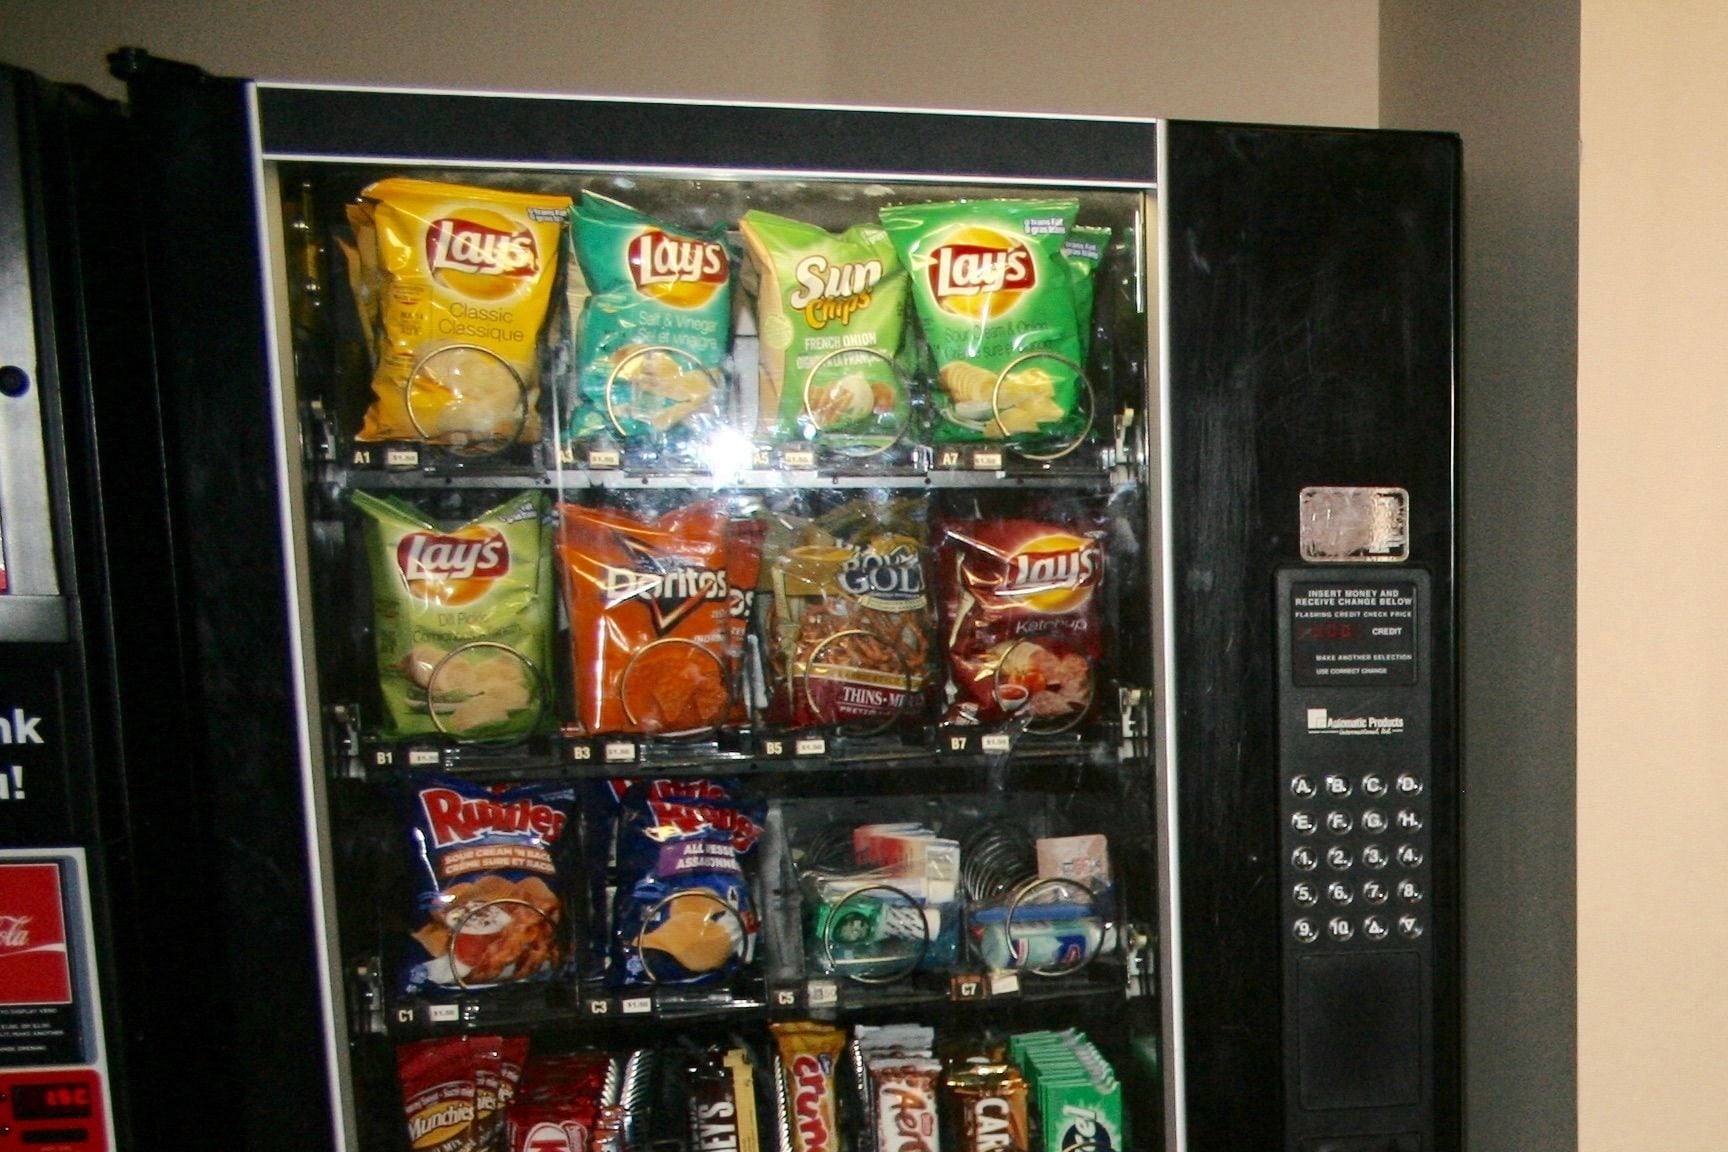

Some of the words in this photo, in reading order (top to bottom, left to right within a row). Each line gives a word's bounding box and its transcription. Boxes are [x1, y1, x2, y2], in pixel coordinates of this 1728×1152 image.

[434, 220, 535, 275] Lay's
[640, 235, 721, 285] Lay's
[938, 247, 1027, 296] Lay's
[791, 255, 883, 309] Sun
[450, 302, 513, 324] Classic
[804, 292, 873, 330] Chips
[439, 318, 524, 342] Classique
[805, 335, 841, 351] FRENCH
[843, 332, 877, 348] ONION
[354, 451, 371, 464] A1
[942, 451, 960, 466] A7
[407, 535, 503, 581] Lay's
[606, 566, 728, 600] Doritos
[839, 566, 924, 595] GOL
[1308, 589, 1342, 598] INSERT
[1344, 589, 1378, 598] MONEY
[1380, 589, 1399, 598] AND
[1016, 617, 1088, 635] Ketchup
[1371, 627, 1402, 636] CREDIT
[842, 687, 883, 707] THINS
[574, 746, 591, 760] B3
[766, 742, 782, 755] B5
[951, 737, 967, 751] B7
[376, 751, 393, 765] B1
[684, 843, 704, 855] ALL
[777, 991, 795, 1005] C5
[961, 983, 977, 996] C7
[398, 1009, 414, 1023] C1
[591, 1000, 607, 1014] C3
[408, 1103, 475, 1140] Munchies
